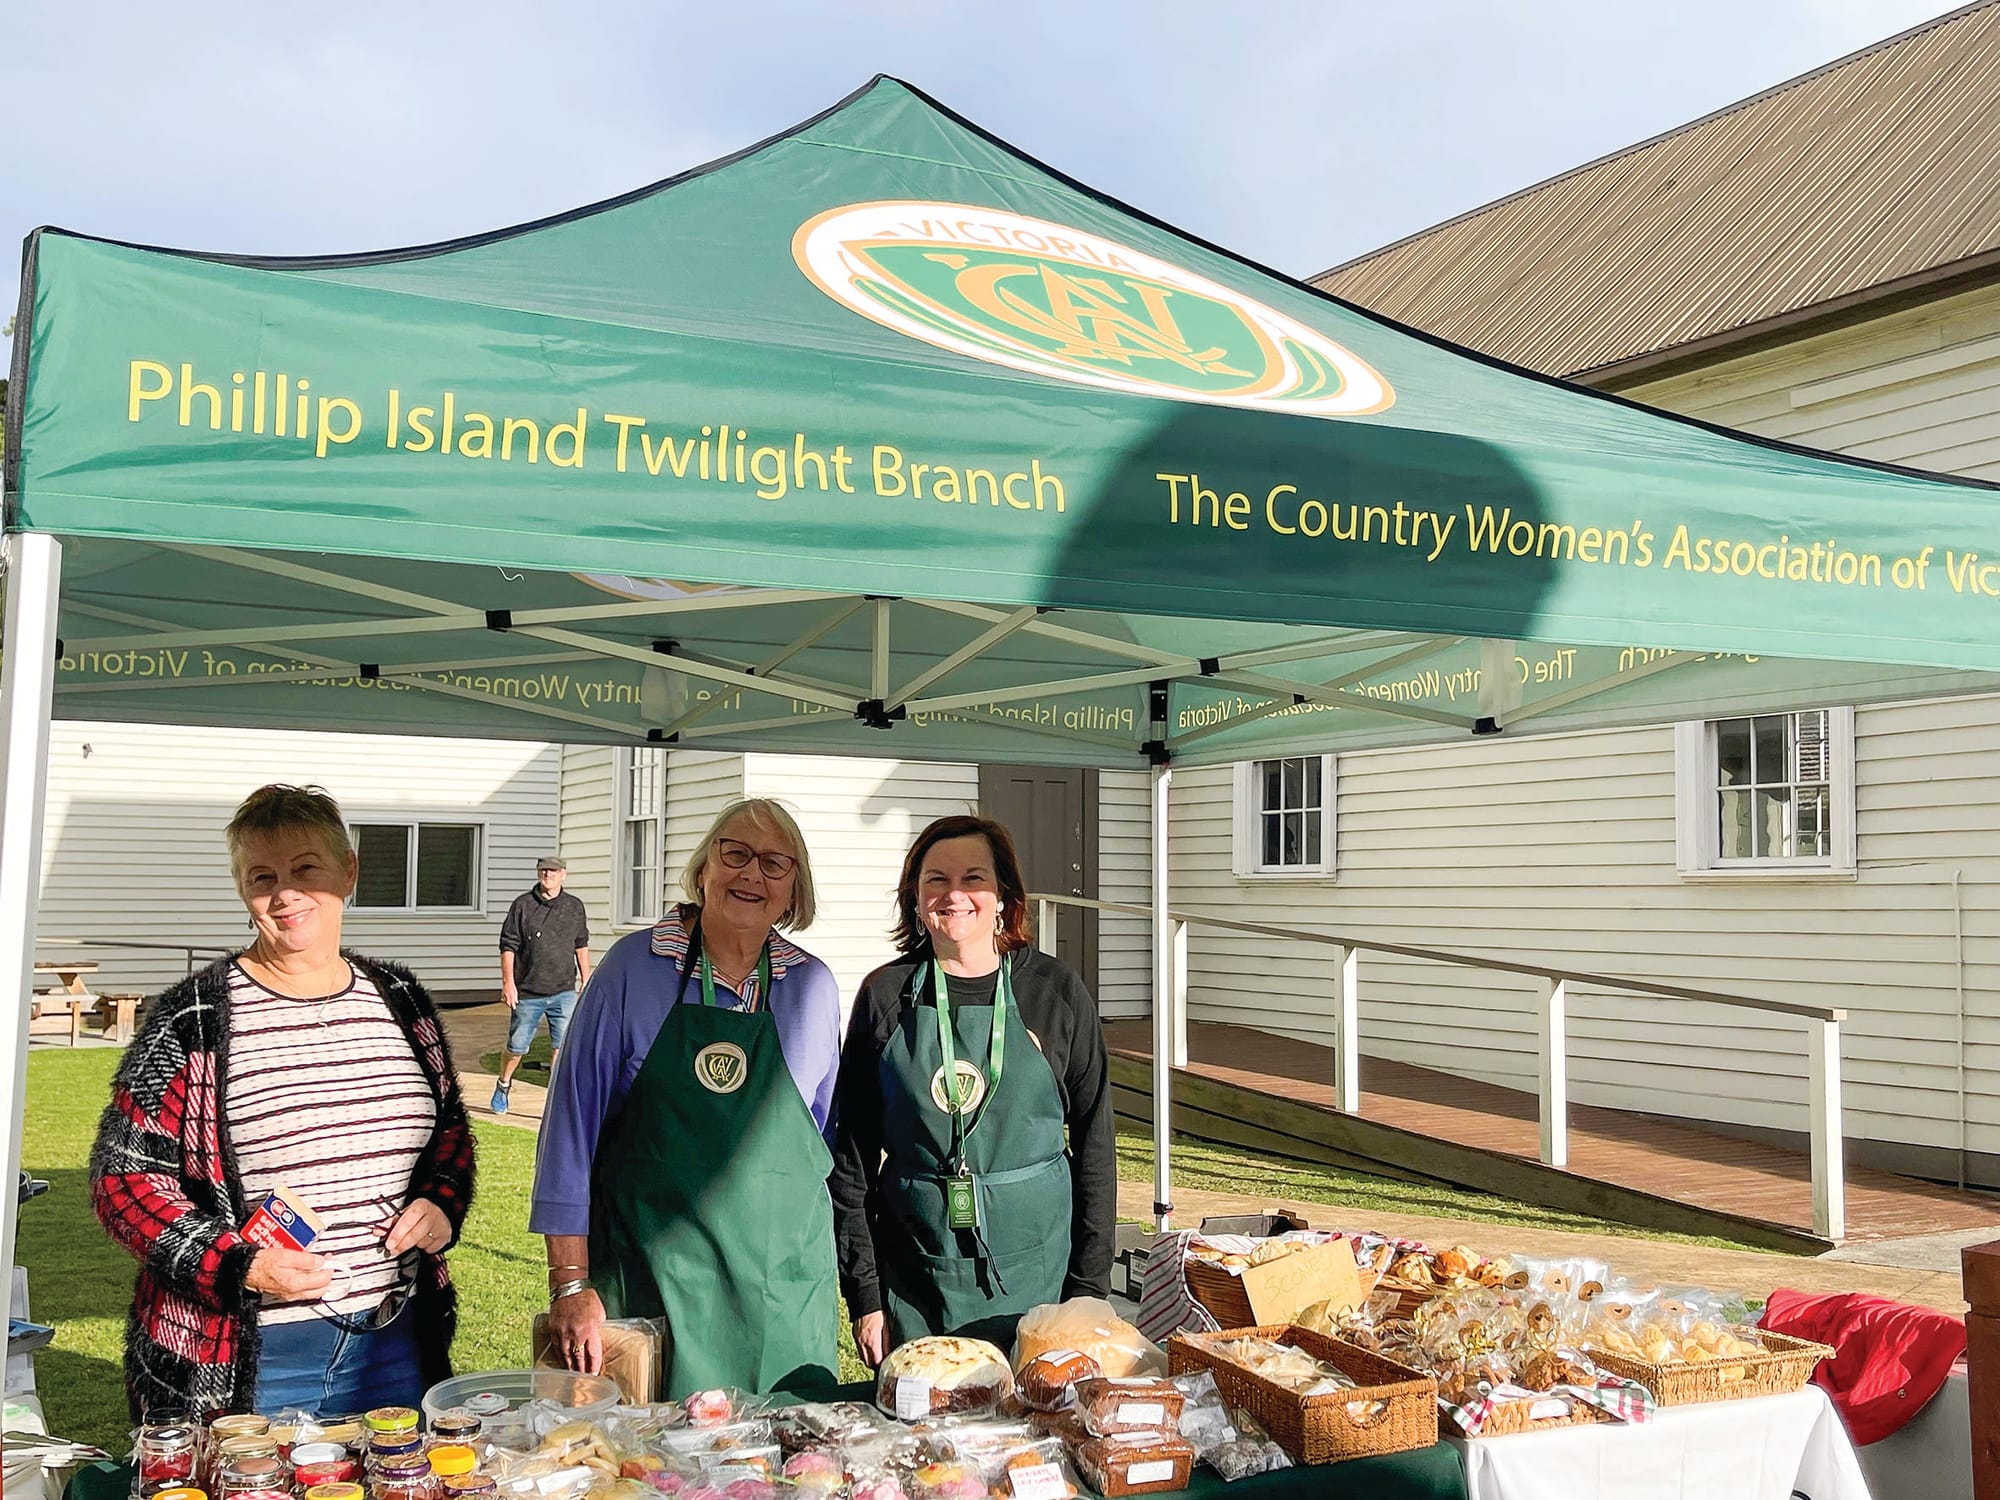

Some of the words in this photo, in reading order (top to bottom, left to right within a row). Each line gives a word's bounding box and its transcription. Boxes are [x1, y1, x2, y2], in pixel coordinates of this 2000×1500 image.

[897, 218, 1140, 273] VICTORIA
[128, 360, 362, 458] Phillip
[387, 389, 587, 467] Island
[604, 413, 854, 503] Twilight
[872, 445, 1066, 511] Branch
[1156, 473, 1251, 530] The
[1266, 484, 1456, 561] Country
[1465, 505, 1653, 567] Women's
[1663, 527, 1880, 585] Association
[1891, 546, 1934, 588] of
[1945, 551, 2000, 596] Vic
